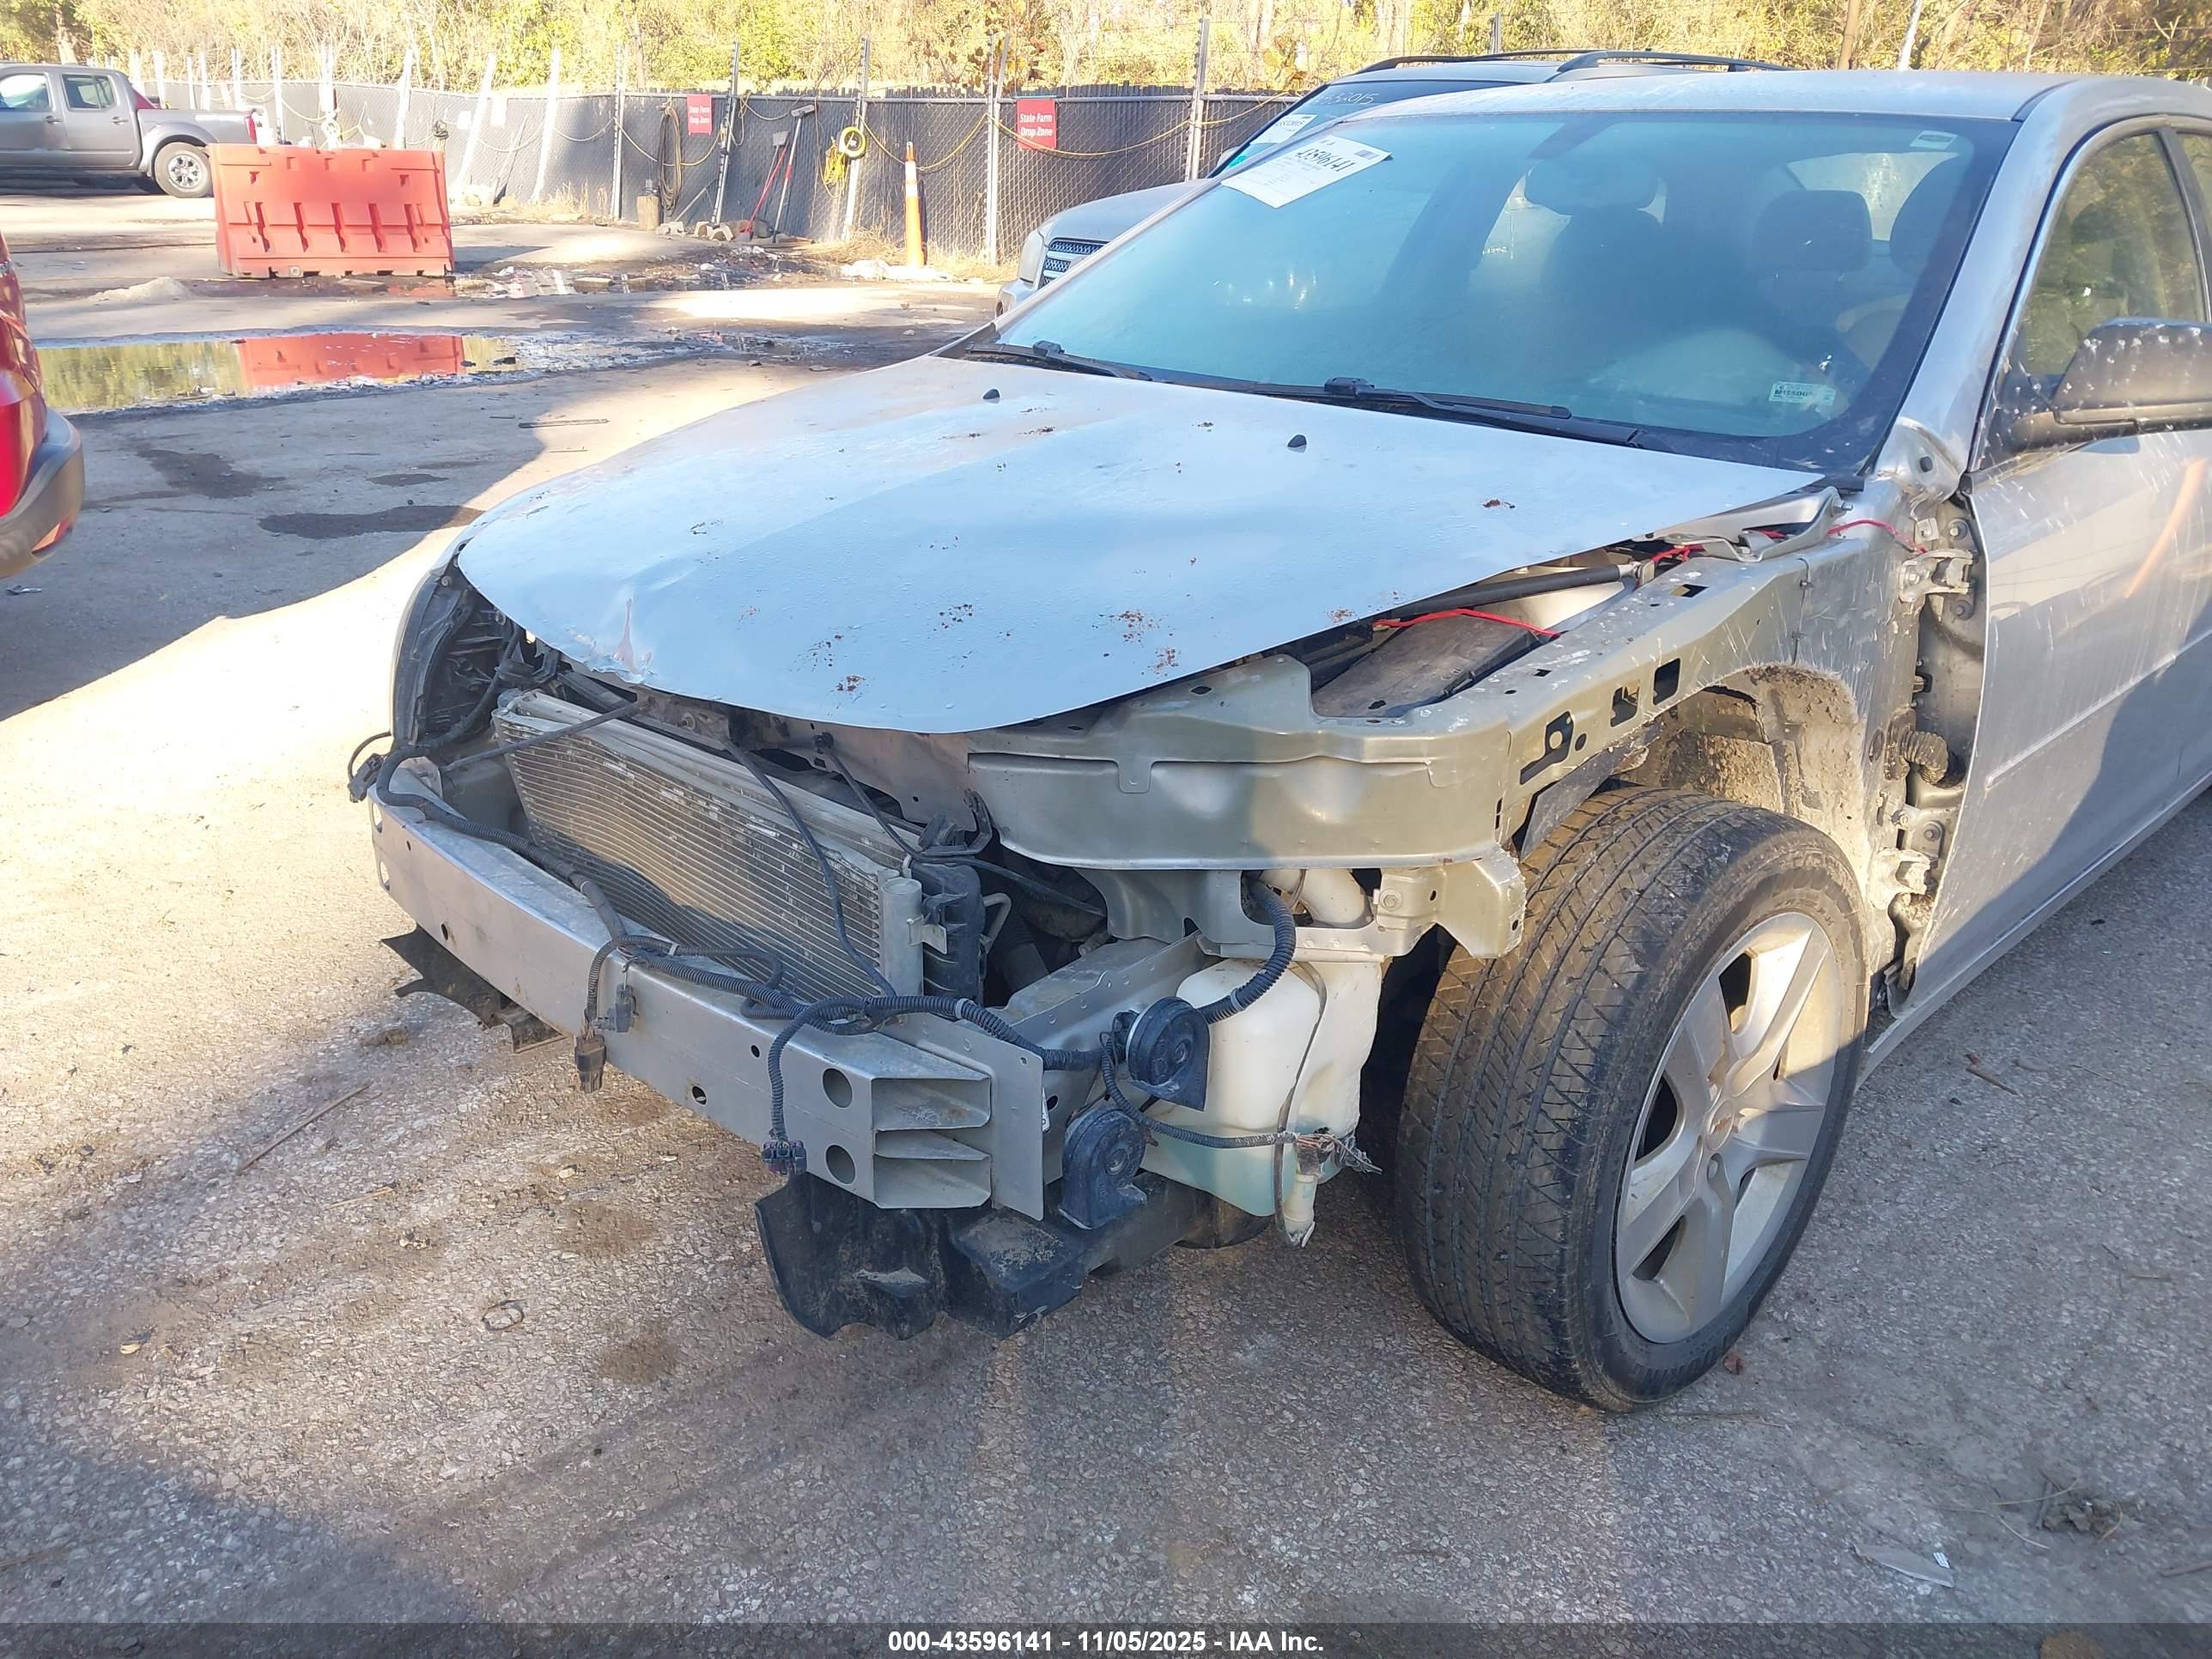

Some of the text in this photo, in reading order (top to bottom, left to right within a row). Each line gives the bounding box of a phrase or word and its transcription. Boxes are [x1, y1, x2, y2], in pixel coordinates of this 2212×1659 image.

[1019, 112, 1053, 123] State Farm
[1020, 126, 1053, 138] Drop Zone
[1295, 148, 1356, 172] 43596141
